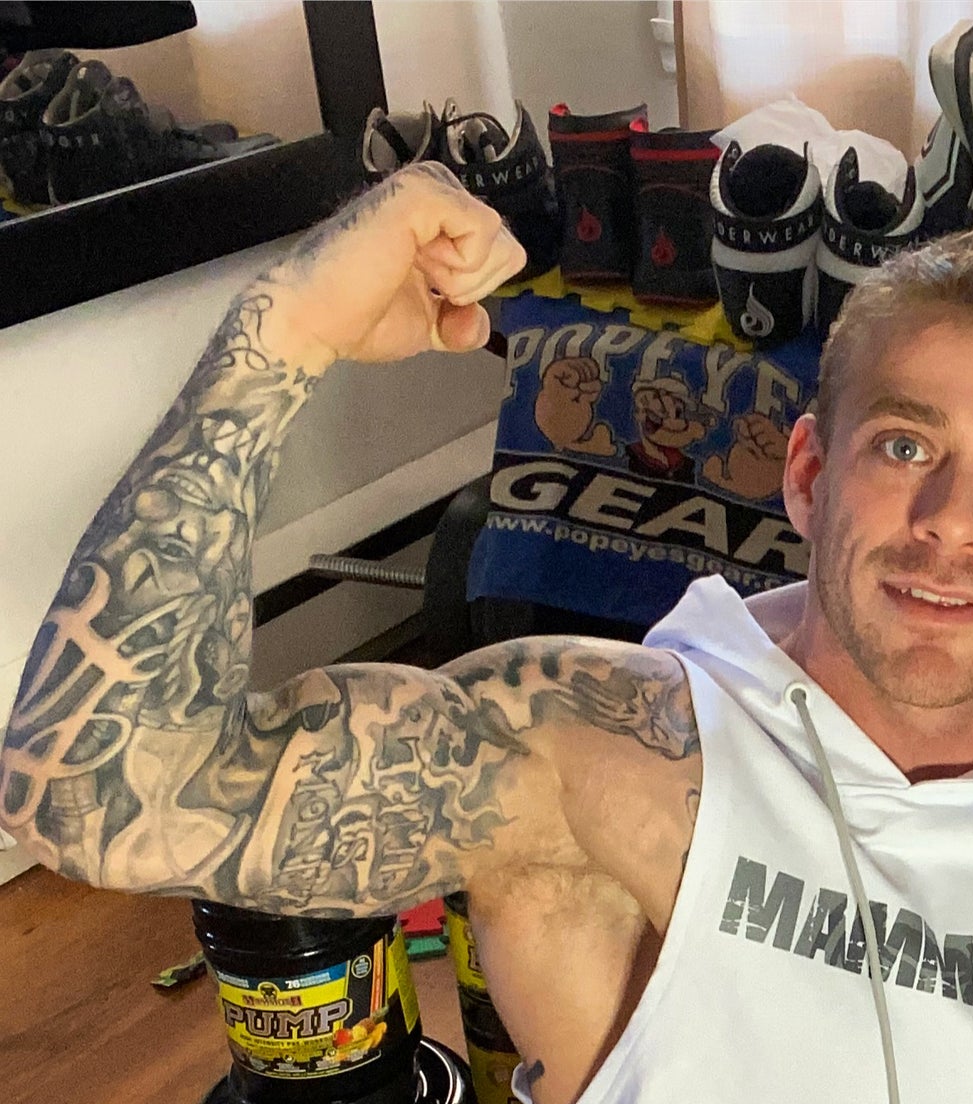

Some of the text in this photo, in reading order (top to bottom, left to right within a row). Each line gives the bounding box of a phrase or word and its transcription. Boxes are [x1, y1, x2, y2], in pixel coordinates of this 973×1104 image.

[505, 323, 818, 417] POPEYE
[490, 460, 810, 577] GEAR
[222, 998, 352, 1040] PUMP
